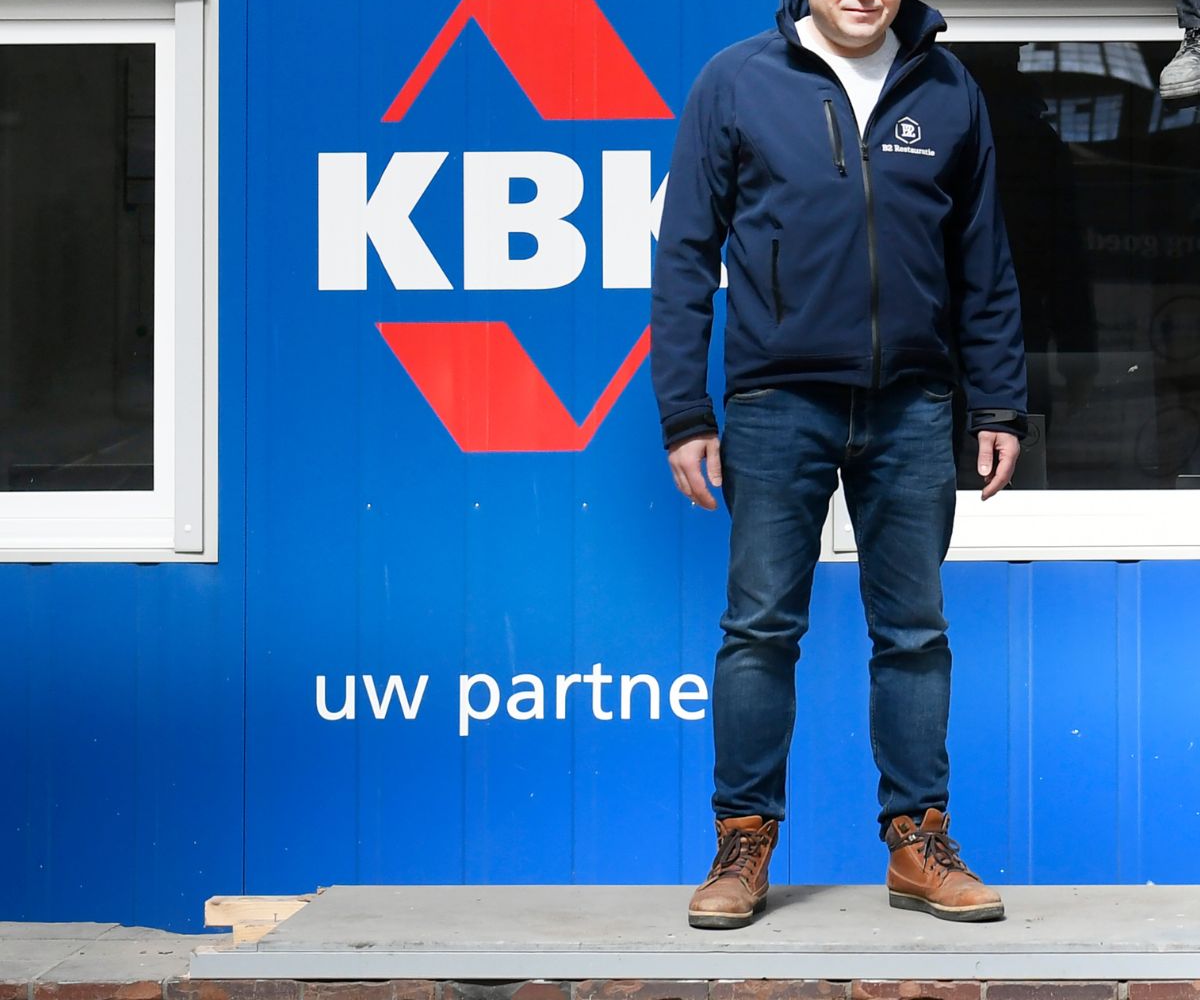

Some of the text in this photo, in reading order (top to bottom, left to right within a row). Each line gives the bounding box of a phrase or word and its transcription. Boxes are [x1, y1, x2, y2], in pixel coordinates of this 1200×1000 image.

[882, 143, 936, 156] B2 Restauratie
[315, 662, 709, 737] uw partne
